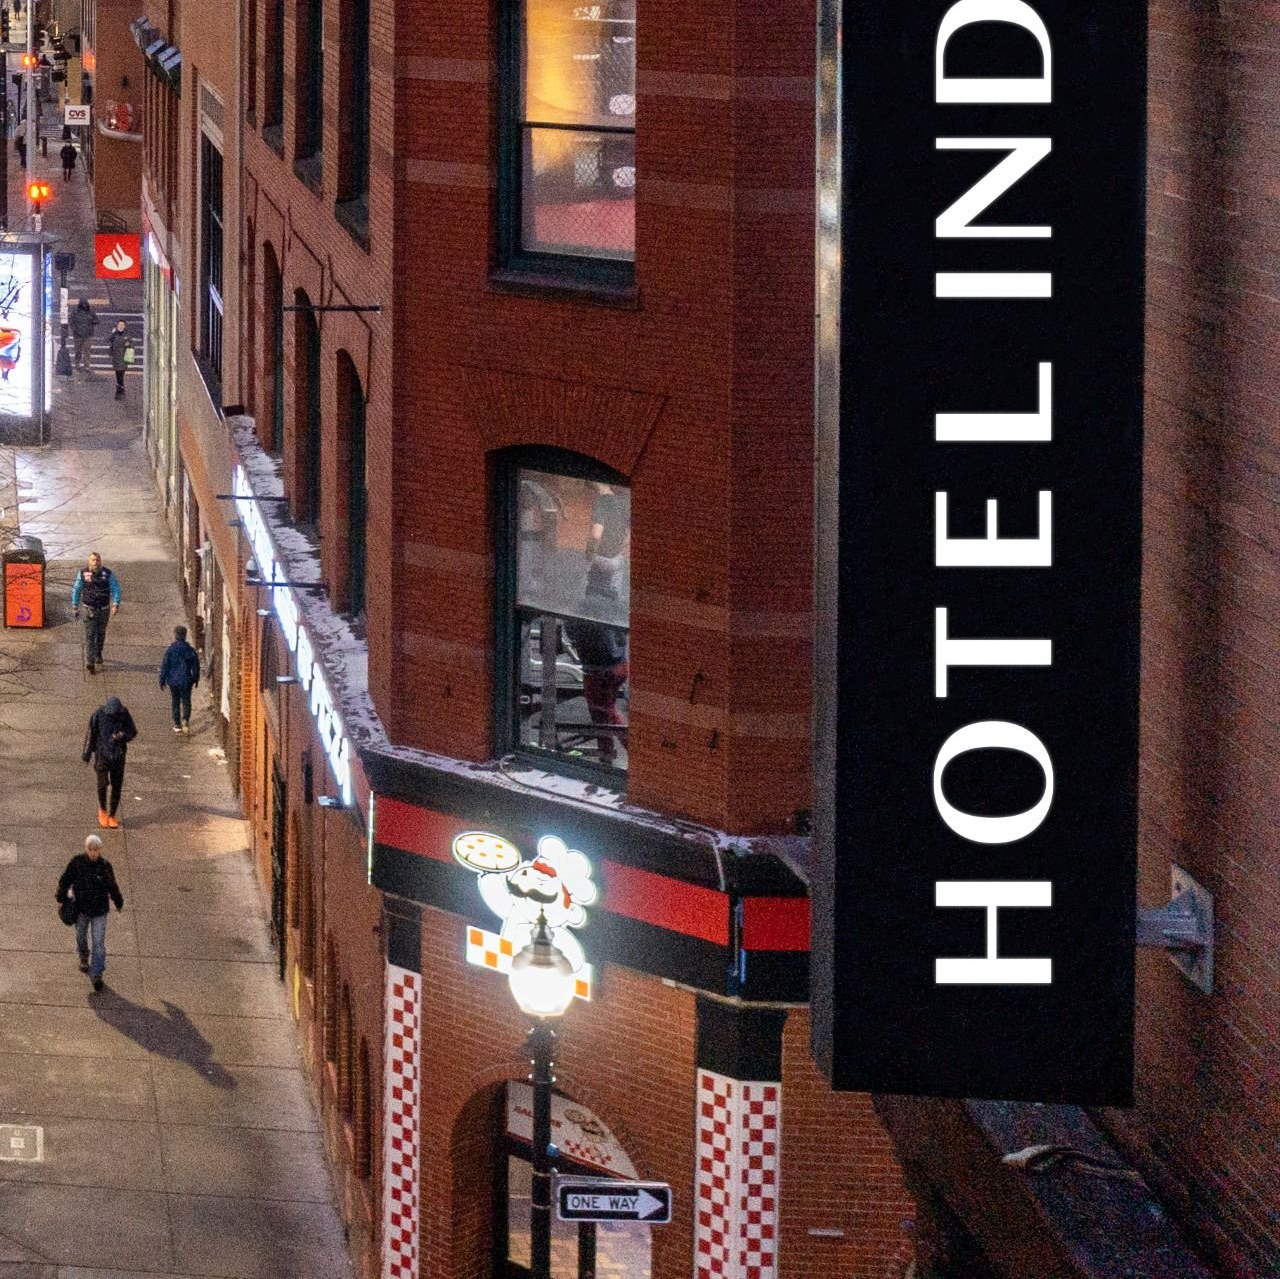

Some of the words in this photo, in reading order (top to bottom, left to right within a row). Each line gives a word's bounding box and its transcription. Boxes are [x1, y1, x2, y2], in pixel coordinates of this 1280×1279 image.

[933, 361, 1054, 985] HOTEL
[571, 1196, 600, 1210] ONE
[609, 1196, 638, 1210] WAY
